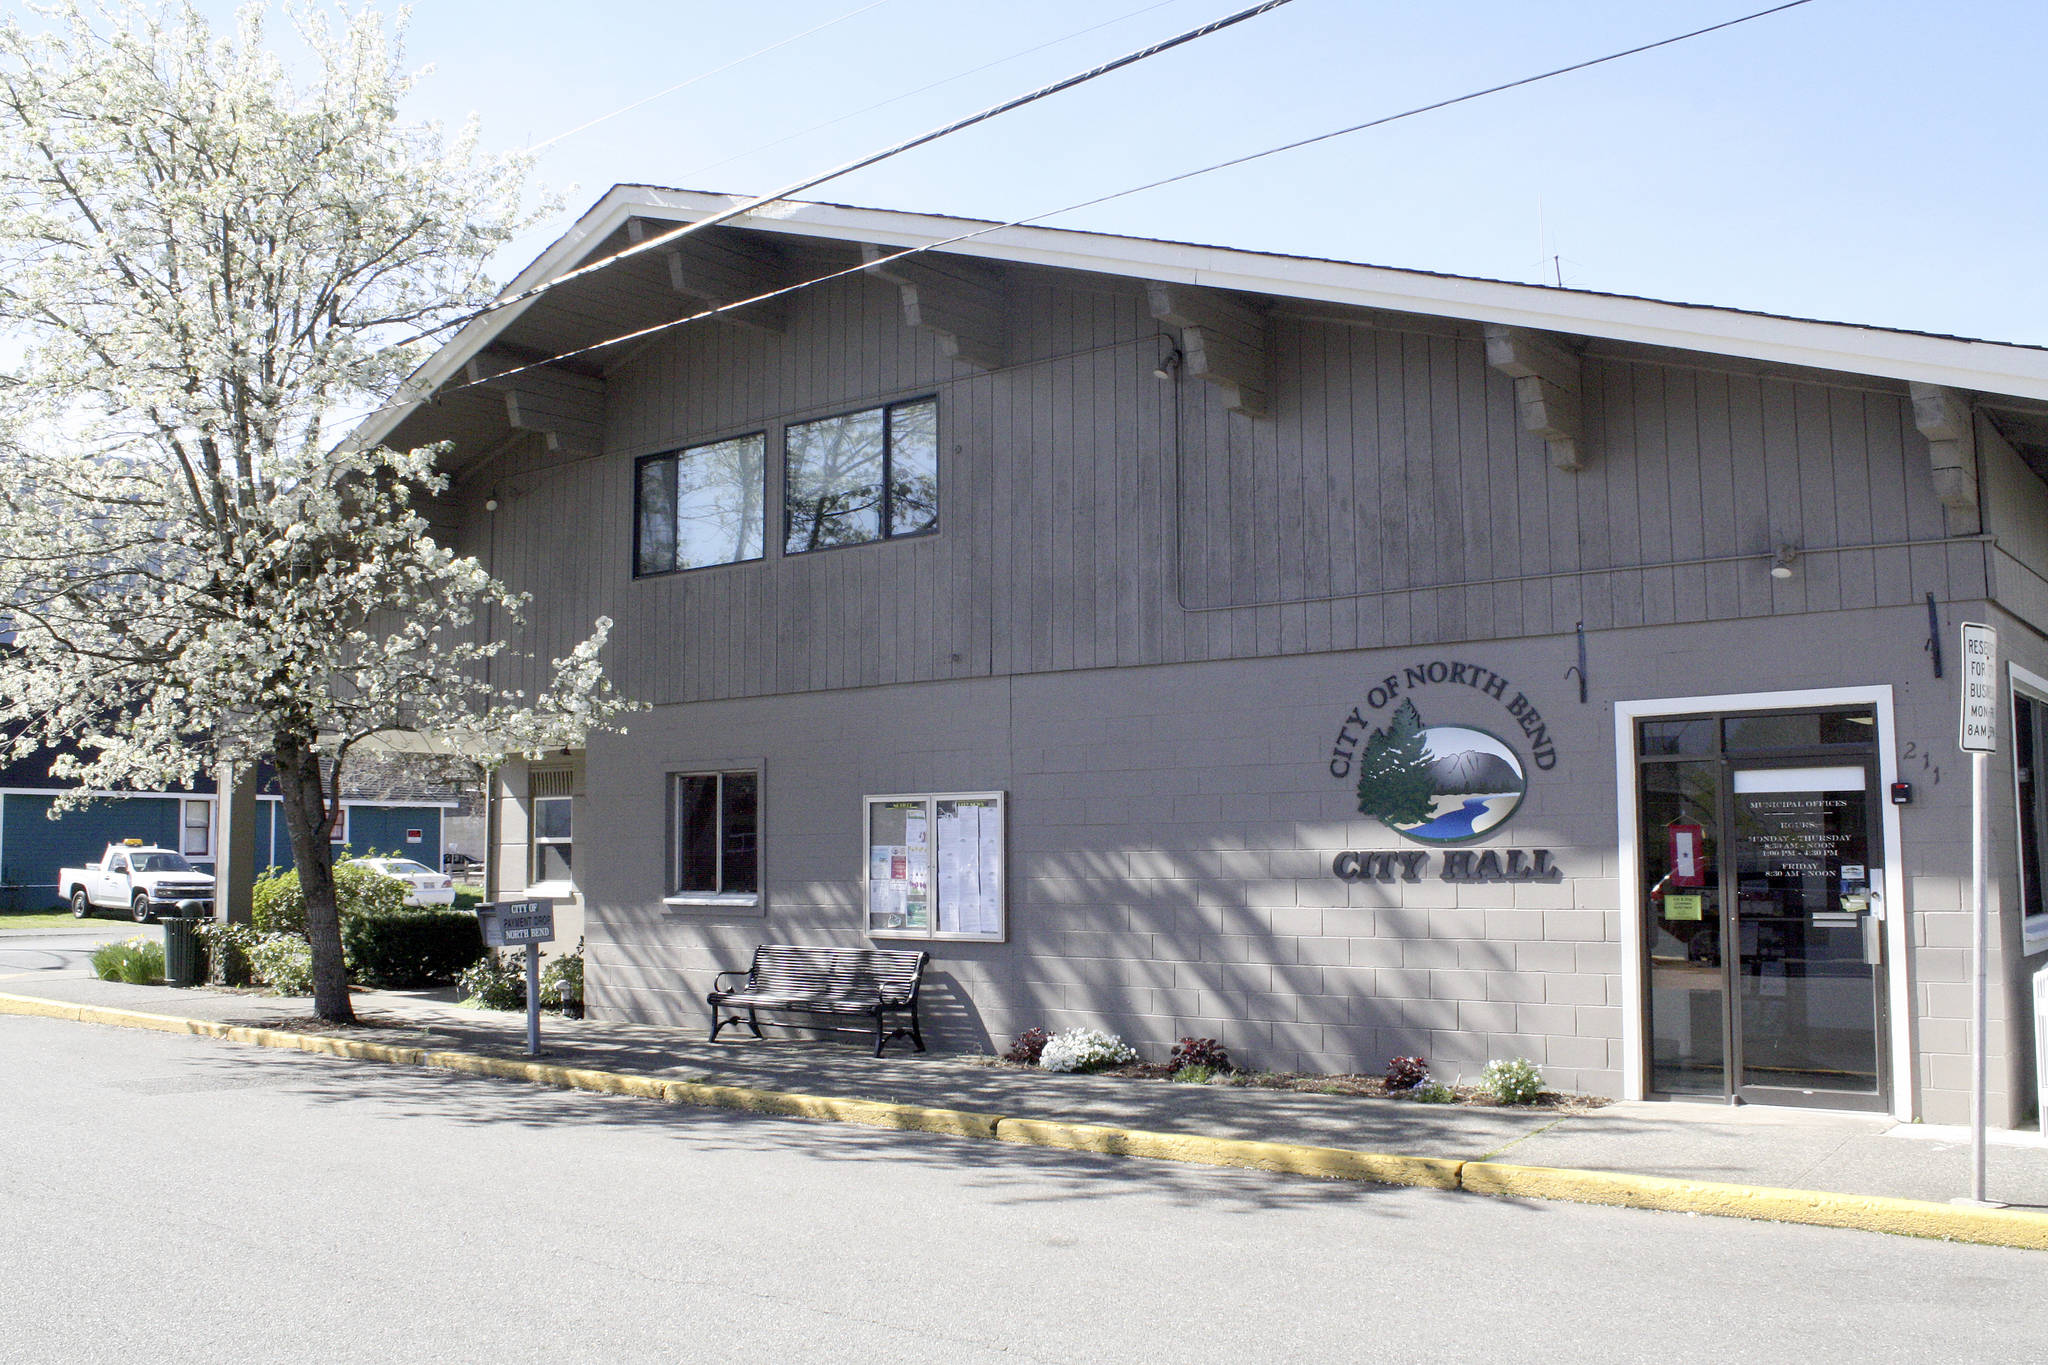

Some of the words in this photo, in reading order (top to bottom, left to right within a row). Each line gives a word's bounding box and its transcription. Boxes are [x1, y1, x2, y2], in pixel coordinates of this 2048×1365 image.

[1971, 661, 1986, 677] FOR
[1330, 706, 1369, 779] CITY
[1367, 675, 1400, 709] OF
[1403, 661, 1509, 701] NORTH
[1505, 692, 1557, 771] BEND
[1750, 801, 1804, 809] MUNICIPAL
[1805, 800, 1847, 808] OFFICES
[1797, 834, 1852, 842] THURSDAY
[1332, 850, 1428, 881] CITY
[1440, 849, 1559, 882] HALL
[511, 904, 527, 913] CITY
[528, 903, 537, 912] OF
[504, 917, 532, 927] PAYMENT
[505, 928, 529, 939] NORTH
[531, 928, 550, 937] BEND
